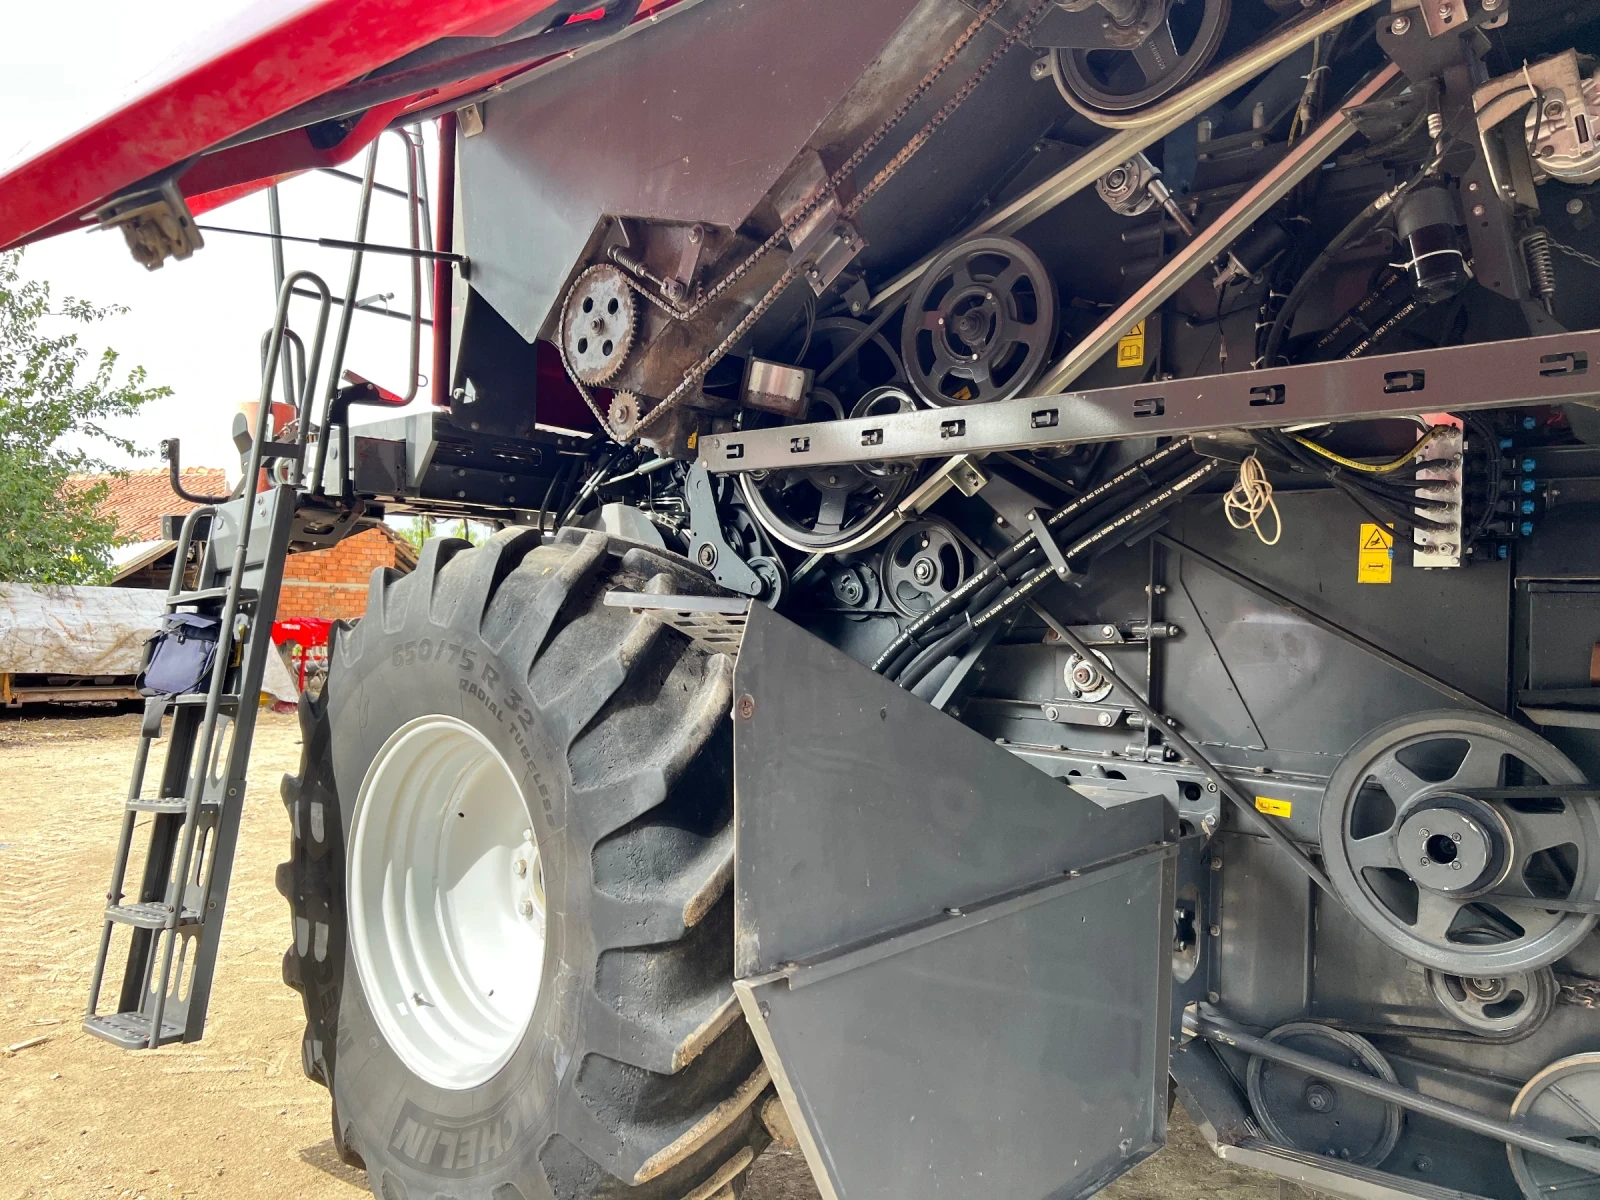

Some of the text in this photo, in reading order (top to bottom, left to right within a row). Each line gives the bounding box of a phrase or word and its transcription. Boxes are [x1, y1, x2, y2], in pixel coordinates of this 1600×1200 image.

[1395, 304, 1414, 319] MSHA
[1318, 334, 1333, 347] ITALY
[1351, 341, 1368, 356] MADE
[1114, 475, 1123, 483] SAE
[1063, 503, 1077, 514] MSHA
[1114, 518, 1125, 526] MPa
[1014, 540, 1025, 551] ITALY
[951, 572, 983, 598] ALFAGOMMA
[1019, 582, 1032, 593] MSHA
[990, 604, 1002, 614] MADE
[974, 616, 986, 626] ITALY
[392, 637, 537, 734] 650/75 R 32
[458, 678, 505, 723] RADIAL
[509, 722, 557, 828] TUBELESS
[392, 1061, 547, 1169] MICHELIN
